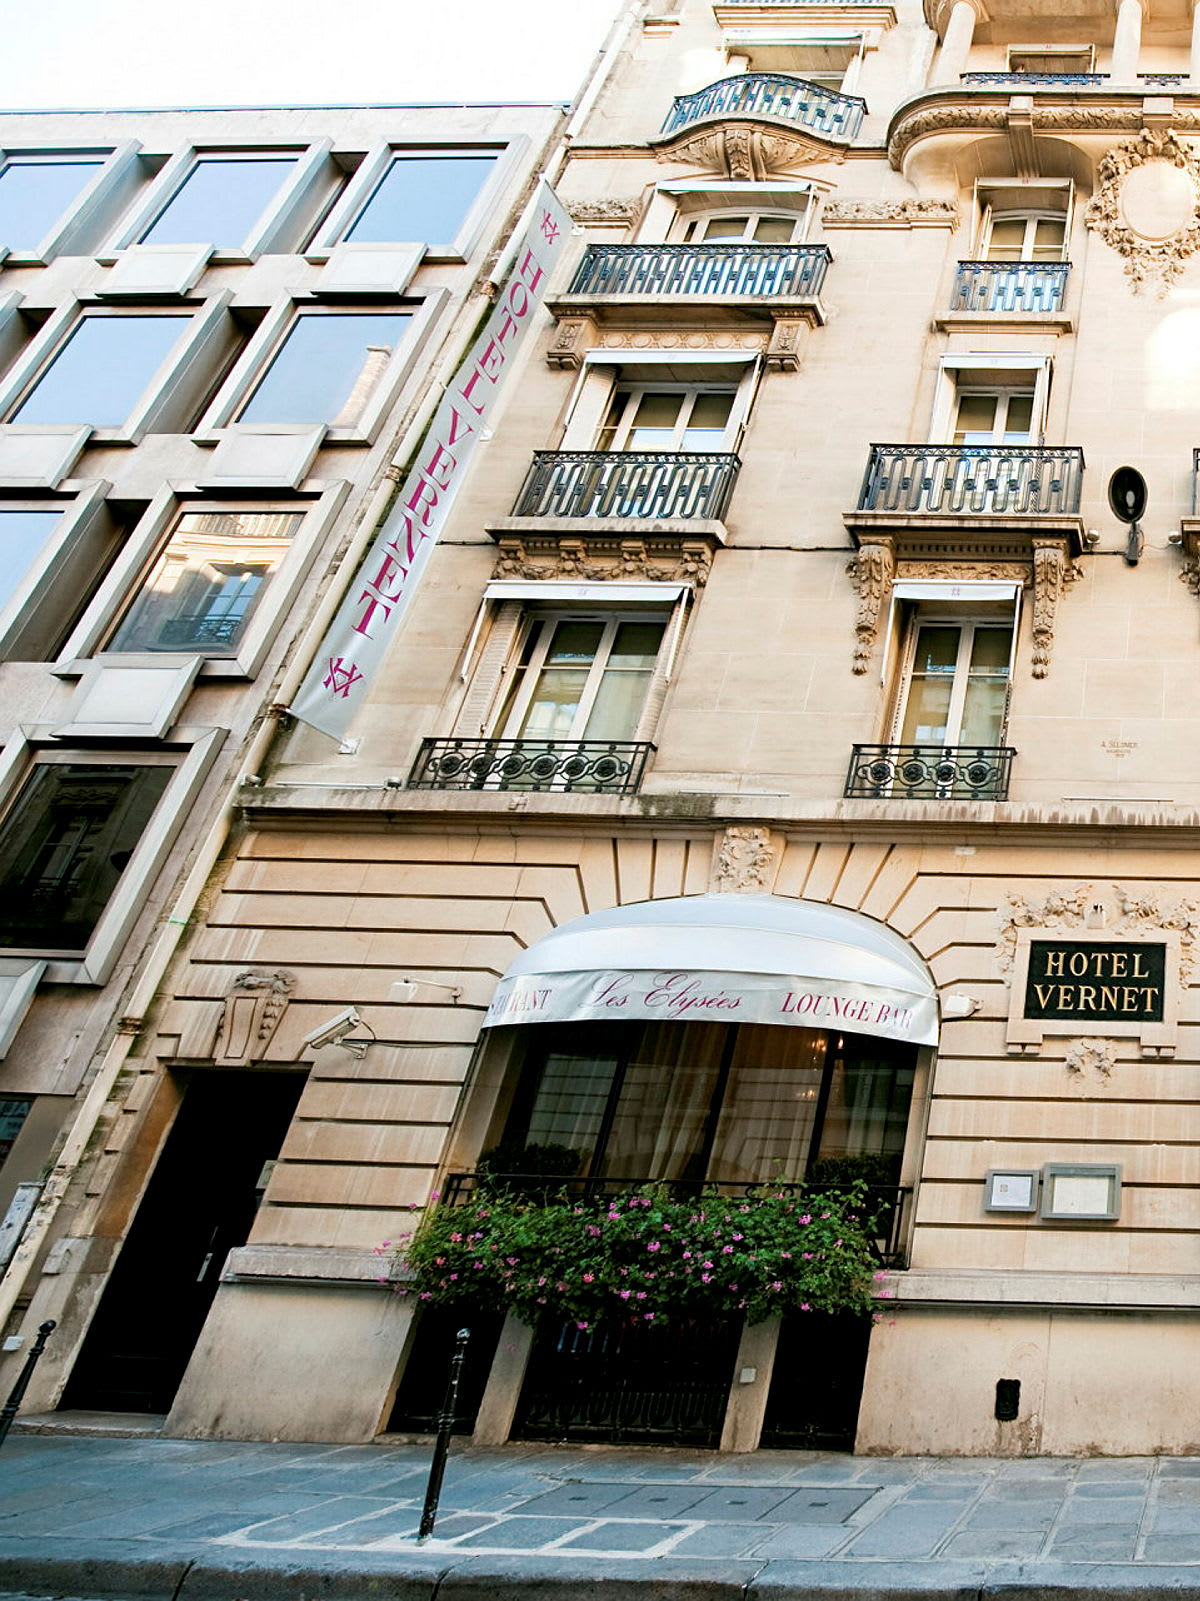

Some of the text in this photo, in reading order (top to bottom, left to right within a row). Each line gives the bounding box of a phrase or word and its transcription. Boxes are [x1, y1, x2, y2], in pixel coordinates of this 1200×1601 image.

[352, 248, 545, 640] HOTEL VERNET
[1044, 951, 1150, 978] HOTEL
[593, 973, 635, 1007] Les
[780, 991, 874, 1022] LOUNGE
[875, 1003, 913, 1030] BAR
[1033, 983, 1159, 1013] VERNET
